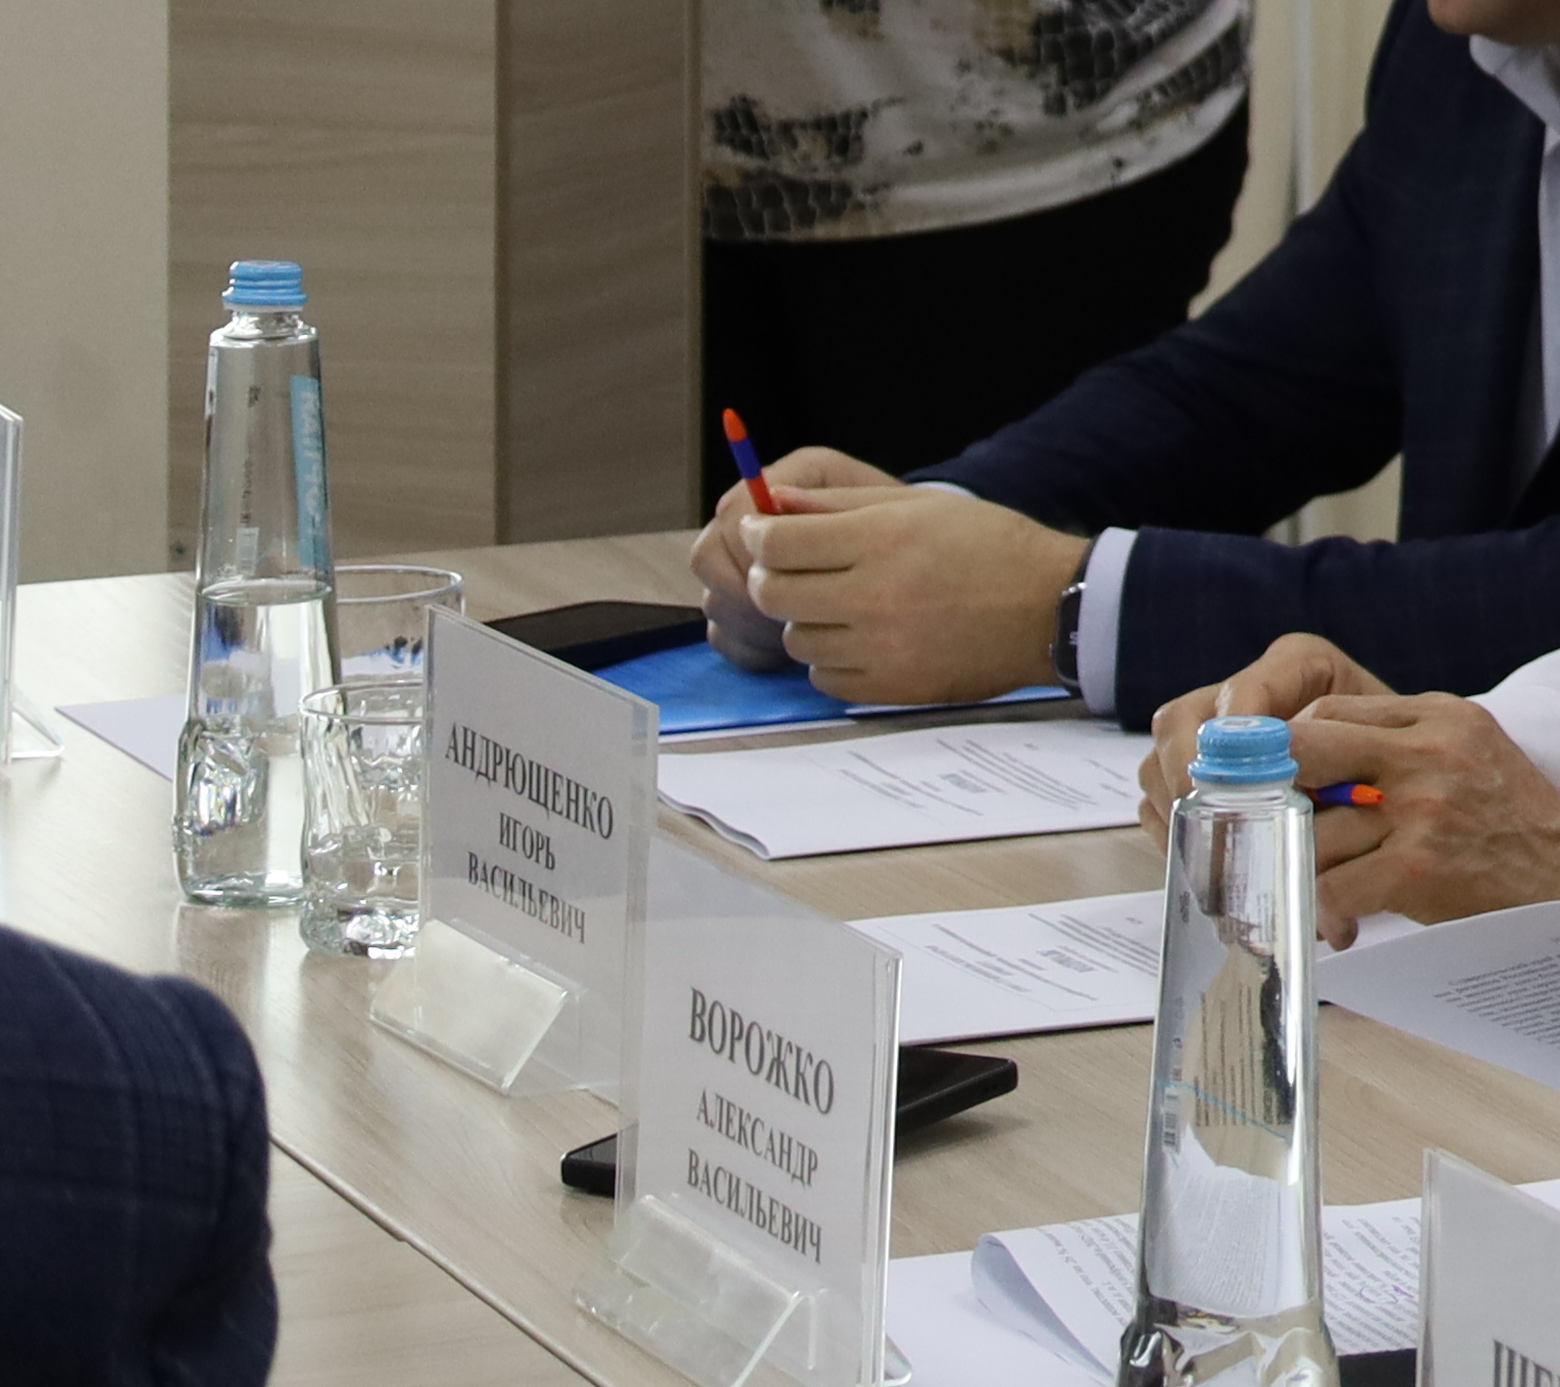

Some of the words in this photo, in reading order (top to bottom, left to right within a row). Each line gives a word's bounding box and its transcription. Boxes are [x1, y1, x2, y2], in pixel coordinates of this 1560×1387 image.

[445, 724, 613, 840] АНДРЮЩЕНКО
[499, 813, 555, 871] ИГОРЬ
[468, 851, 585, 943] ВАСИЛЬЕВИЧ
[689, 988, 834, 1115] ВОРОЖКО
[697, 1090, 818, 1187] АЛЕКСАНДР
[687, 1149, 821, 1264] ВАСИЛЬЕВИЧ
